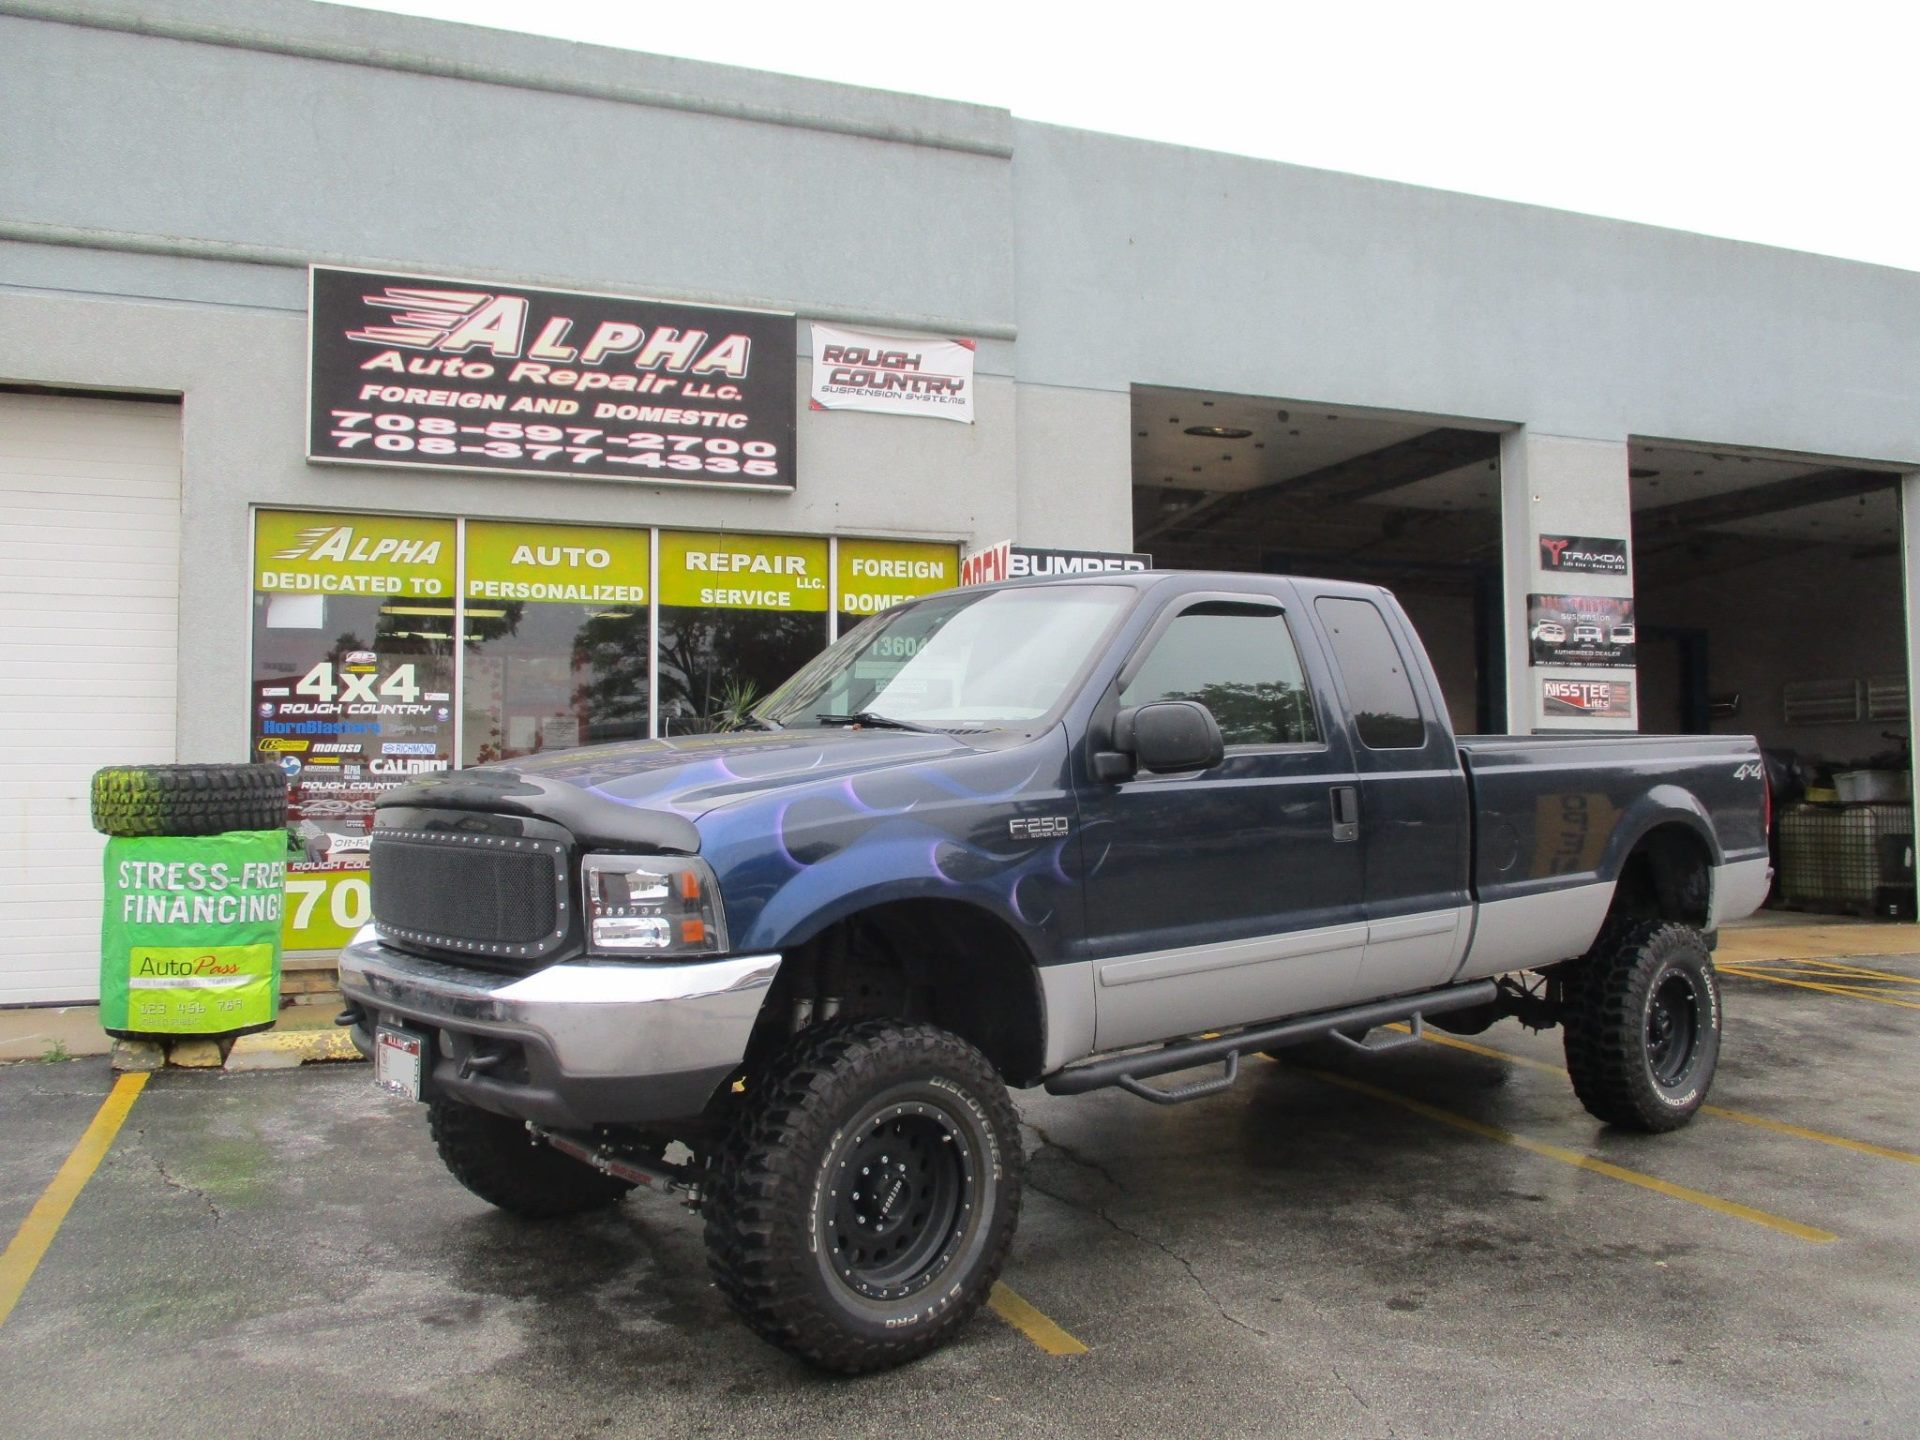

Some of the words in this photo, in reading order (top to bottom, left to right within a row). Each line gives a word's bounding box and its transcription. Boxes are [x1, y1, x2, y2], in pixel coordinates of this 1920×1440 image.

[439, 294, 751, 378] ALPHA
[822, 344, 922, 370] ROUGH
[360, 350, 495, 379] Auto
[508, 362, 678, 394] Repair
[681, 382, 743, 400] LLC.
[828, 368, 965, 396] COUNTRY
[821, 385, 902, 399] SUSPENSION
[905, 393, 966, 405] SYSTEMS
[359, 384, 507, 410] FOREIGN
[509, 397, 580, 415] AND
[594, 402, 749, 429] DOMESTIC
[330, 409, 778, 457] 708-597-2700
[330, 430, 779, 476] 708-377-4335
[307, 526, 442, 564] ALPHA
[511, 545, 611, 568] AUTO
[1562, 551, 1625, 563] TRAXDA
[685, 551, 807, 575] REPAIR
[796, 578, 826, 590] LLC.
[851, 558, 944, 579] FOREIGN
[262, 571, 402, 593] DEDICATED
[409, 577, 442, 595] TO
[469, 580, 644, 602] PERSONALIZED
[700, 588, 790, 607] SERVICE
[844, 593, 918, 612] DOME
[296, 662, 420, 702] 4x4
[1544, 683, 1609, 698] NISSTEC
[279, 703, 342, 714] ROUGH
[347, 704, 432, 715] COUNTRY
[312, 743, 362, 753] MOROSO
[395, 744, 435, 754] RICHMOND
[369, 758, 448, 775] CALMINI
[300, 782, 346, 790] ROUGH
[350, 782, 402, 791] COUNT
[334, 838, 370, 848] OR-FA
[292, 861, 343, 871] ROUGH
[124, 893, 281, 924] FINANCING!
[929, 1075, 1002, 1181] DISCOVERER
